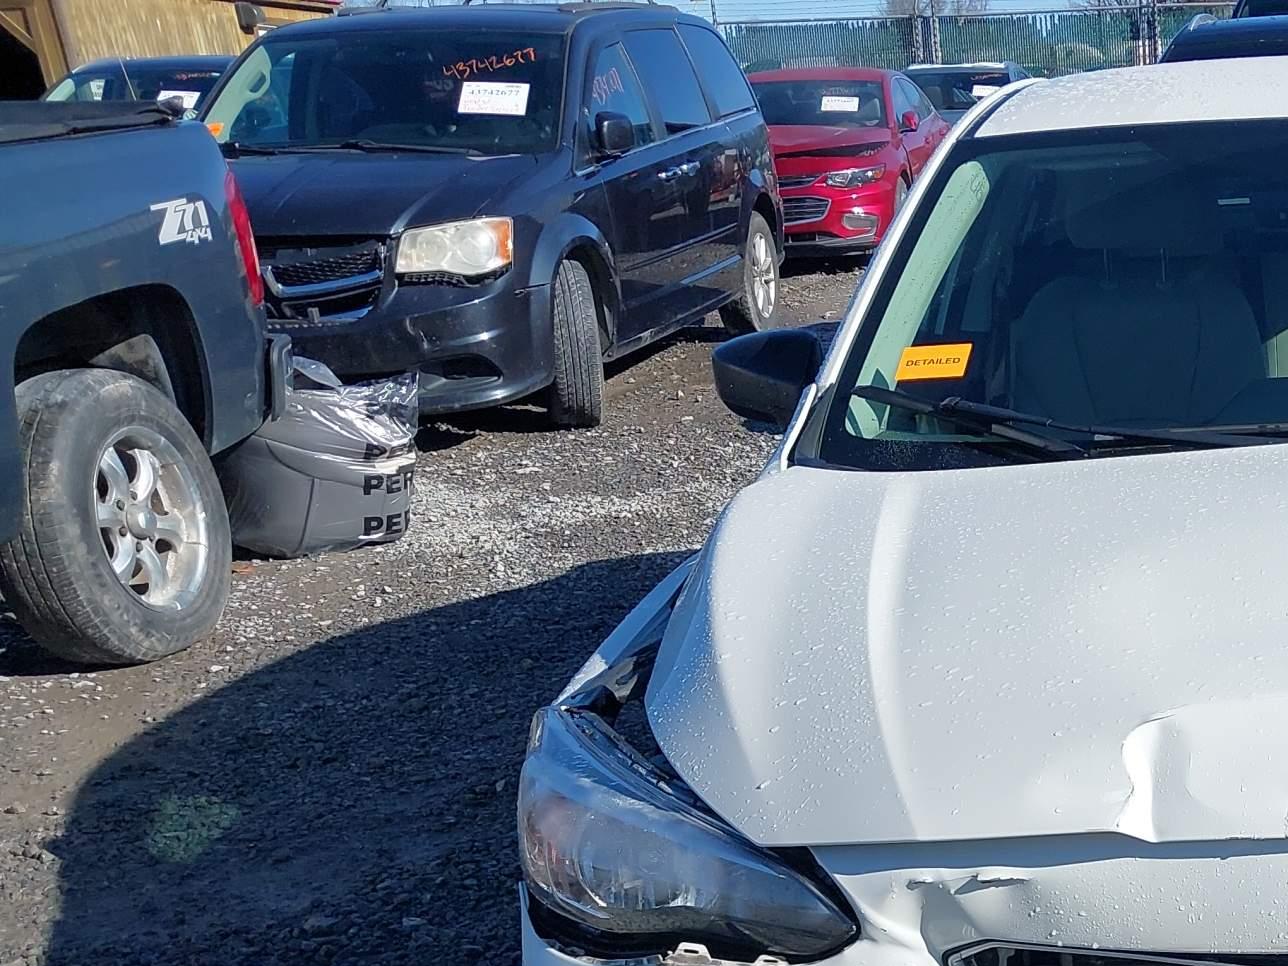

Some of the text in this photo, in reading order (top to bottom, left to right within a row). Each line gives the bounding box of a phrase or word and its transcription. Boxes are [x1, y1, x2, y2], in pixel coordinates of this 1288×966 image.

[443, 47, 537, 79] 43742677
[149, 197, 210, 246] Z71
[905, 356, 961, 367] DETAILED
